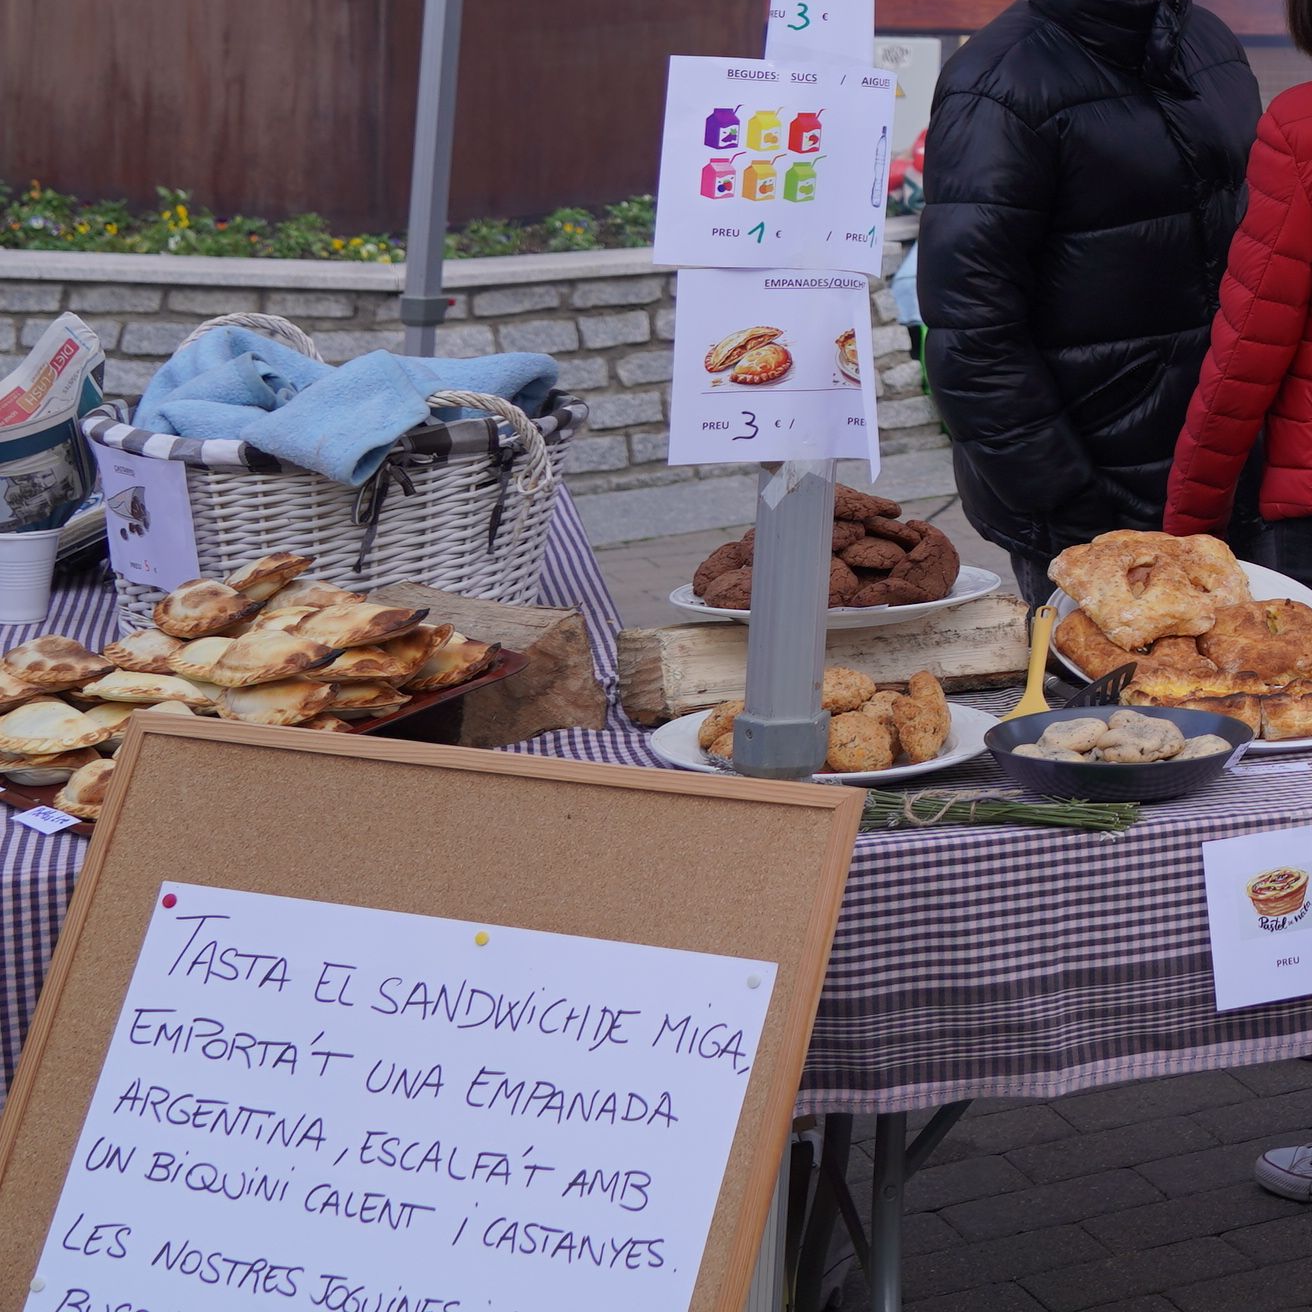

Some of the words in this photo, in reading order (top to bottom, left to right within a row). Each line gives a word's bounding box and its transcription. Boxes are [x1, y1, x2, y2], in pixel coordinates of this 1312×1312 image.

[787, 2, 810, 31] 3
[822, 12, 829, 22] €
[790, 72, 818, 83] SUCS
[711, 228, 740, 238] PREU
[747, 221, 765, 244] 1
[845, 232, 869, 243] PREU
[702, 421, 730, 431] PREU
[732, 410, 759, 441] 3
[774, 419, 782, 429] €
[168, 915, 293, 993] TASTA
[314, 961, 358, 1007] EL
[1276, 956, 1300, 968] PREU
[366, 1060, 444, 1100] UNA
[466, 1065, 679, 1129] EMPANADA
[85, 1137, 137, 1174] UN
[303, 1182, 437, 1231] CALENT
[562, 1168, 652, 1212] AMB
[62, 1213, 132, 1260] LES
[151, 1239, 305, 1297] NOSTRES
